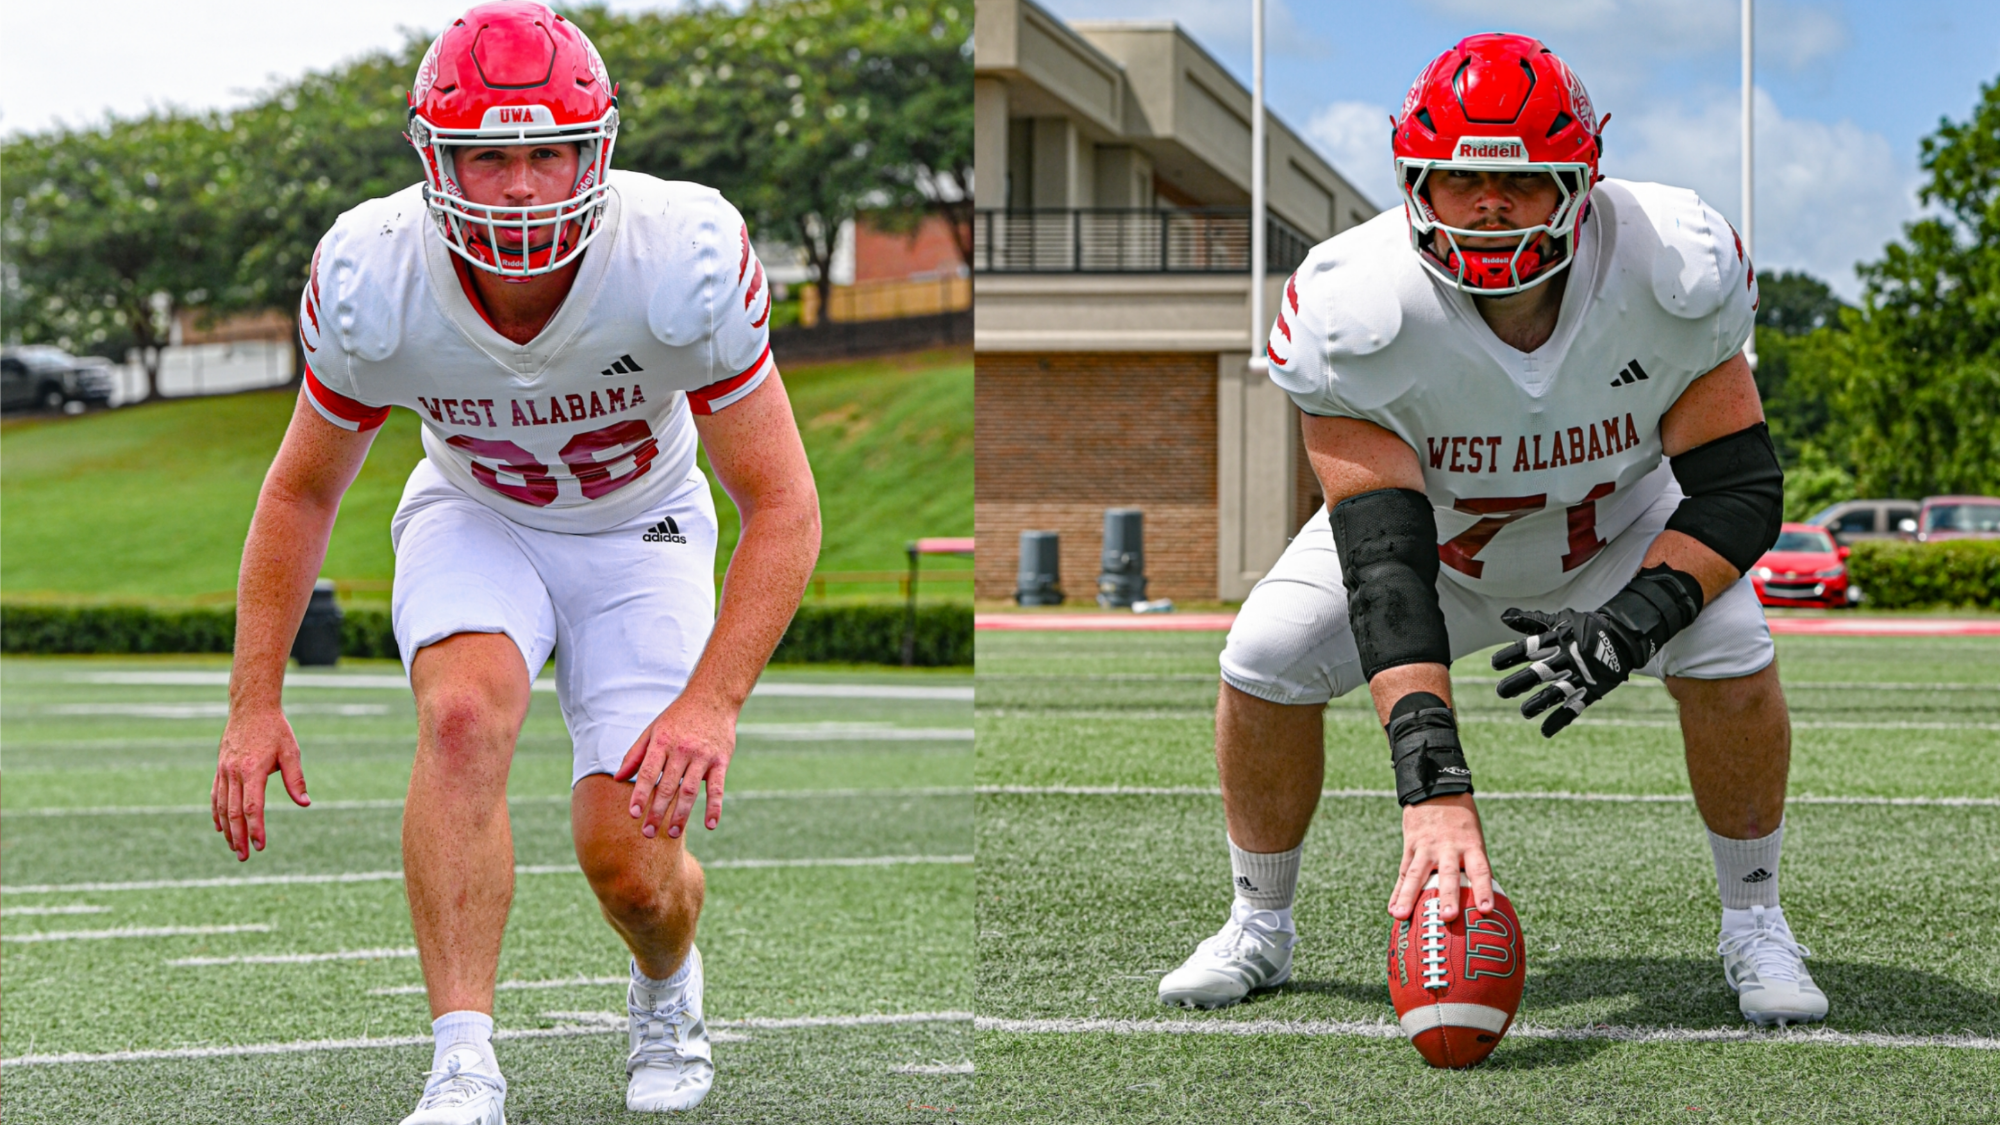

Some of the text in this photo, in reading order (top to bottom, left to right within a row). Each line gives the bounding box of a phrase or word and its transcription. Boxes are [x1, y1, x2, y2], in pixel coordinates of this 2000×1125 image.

[499, 107, 533, 123] UWA
[1460, 143, 1520, 158] Riddell
[1482, 256, 1508, 264] Riddell
[418, 384, 648, 428] WEST ALABAMA
[1427, 412, 1640, 473] WEST ALABAMA
[642, 532, 687, 544] adidas
[1437, 481, 1616, 580] 71
[1598, 630, 1621, 673] adidas
